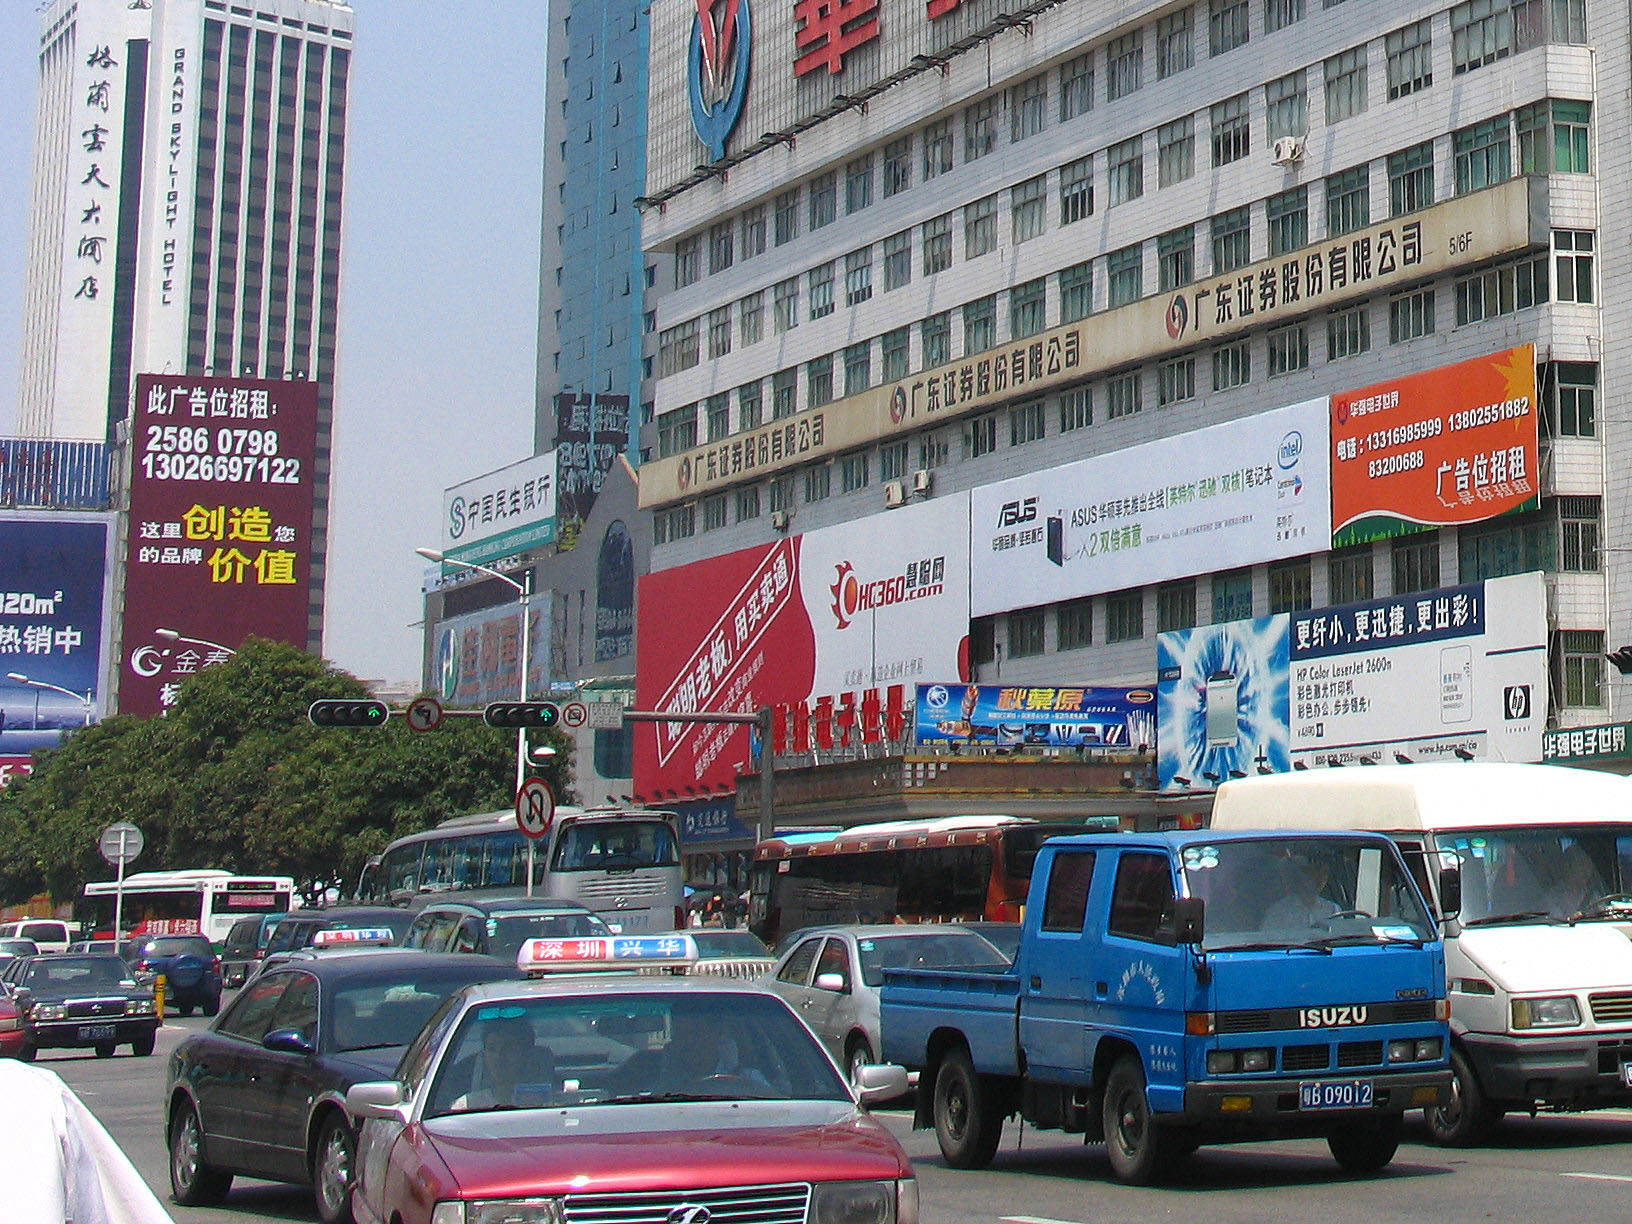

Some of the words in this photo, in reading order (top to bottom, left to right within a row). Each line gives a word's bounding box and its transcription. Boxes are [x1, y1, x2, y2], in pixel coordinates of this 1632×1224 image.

[172, 48, 186, 114] GRAND
[166, 122, 181, 230] SKYLIGHT
[162, 239, 176, 306] HOTEL
[1192, 221, 1424, 333] 广东证券股份有限公司
[909, 329, 1081, 421] 广东证券股份有限公司
[1349, 390, 1400, 418] 华强电子世界
[1447, 396, 1530, 433] 13802551882
[146, 426, 208, 453] 2586
[217, 429, 278, 456] 0798
[141, 455, 300, 484] 13026697122
[1368, 449, 1425, 480] 83200688
[1435, 445, 1527, 497] 广告位招租
[997, 496, 1037, 529] ASUS
[1070, 504, 1098, 528] ASUS
[1543, 725, 1626, 759] 华强电子世界
[538, 939, 600, 960] 深圳
[619, 938, 681, 959] 兴华
[1300, 1006, 1368, 1029] ISUZU
